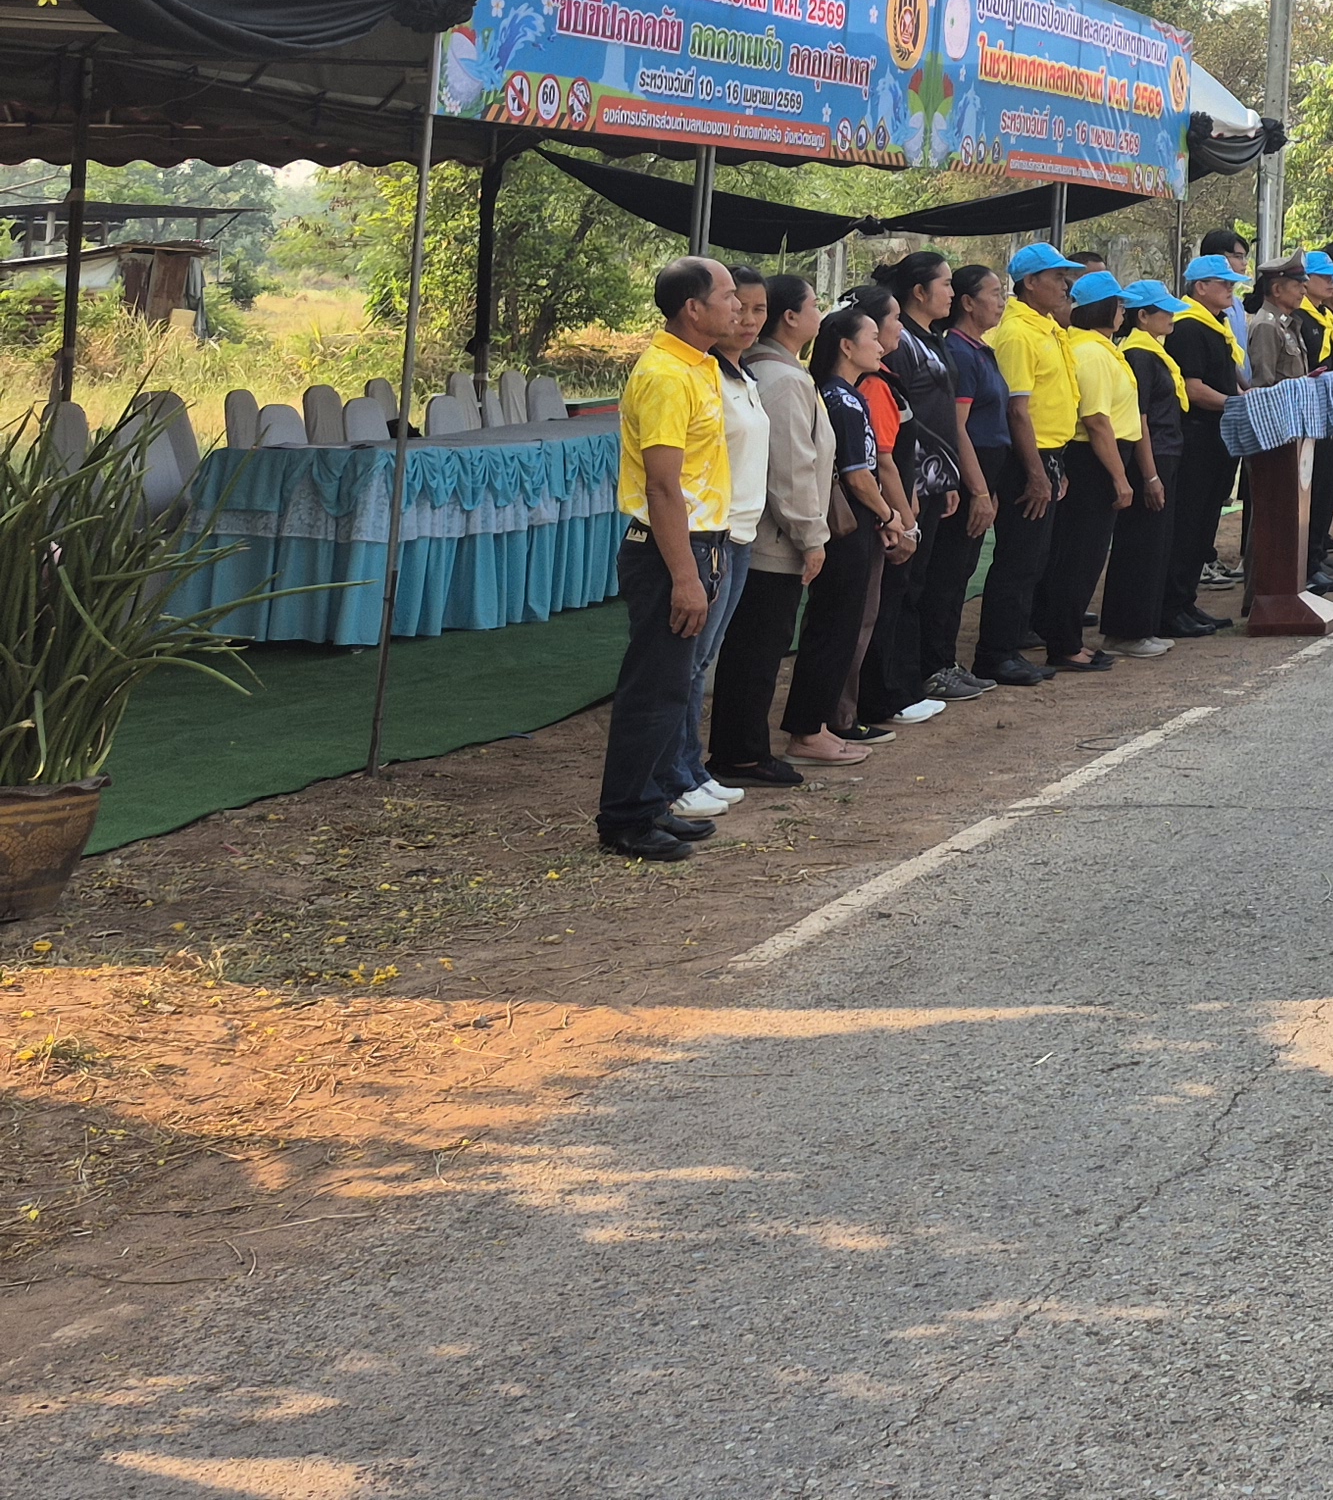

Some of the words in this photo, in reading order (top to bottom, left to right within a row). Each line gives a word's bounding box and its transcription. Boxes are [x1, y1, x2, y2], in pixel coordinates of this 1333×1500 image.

[689, 24, 783, 70] ลดความเร็ว
[541, 83, 556, 106] 60
[639, 65, 695, 96] ระหว่างวันที่
[699, 77, 713, 99] 10
[726, 81, 739, 103] 16
[776, 91, 803, 112] 2569
[978, 33, 1106, 103] ในช่วงเทศกาลสงกรานต์
[1133, 83, 1163, 119] 2569
[1000, 105, 1050, 138] ระหว่างวันที่
[1052, 116, 1065, 141] 10
[1075, 120, 1087, 144] 16
[1118, 130, 1141, 156] 2569
